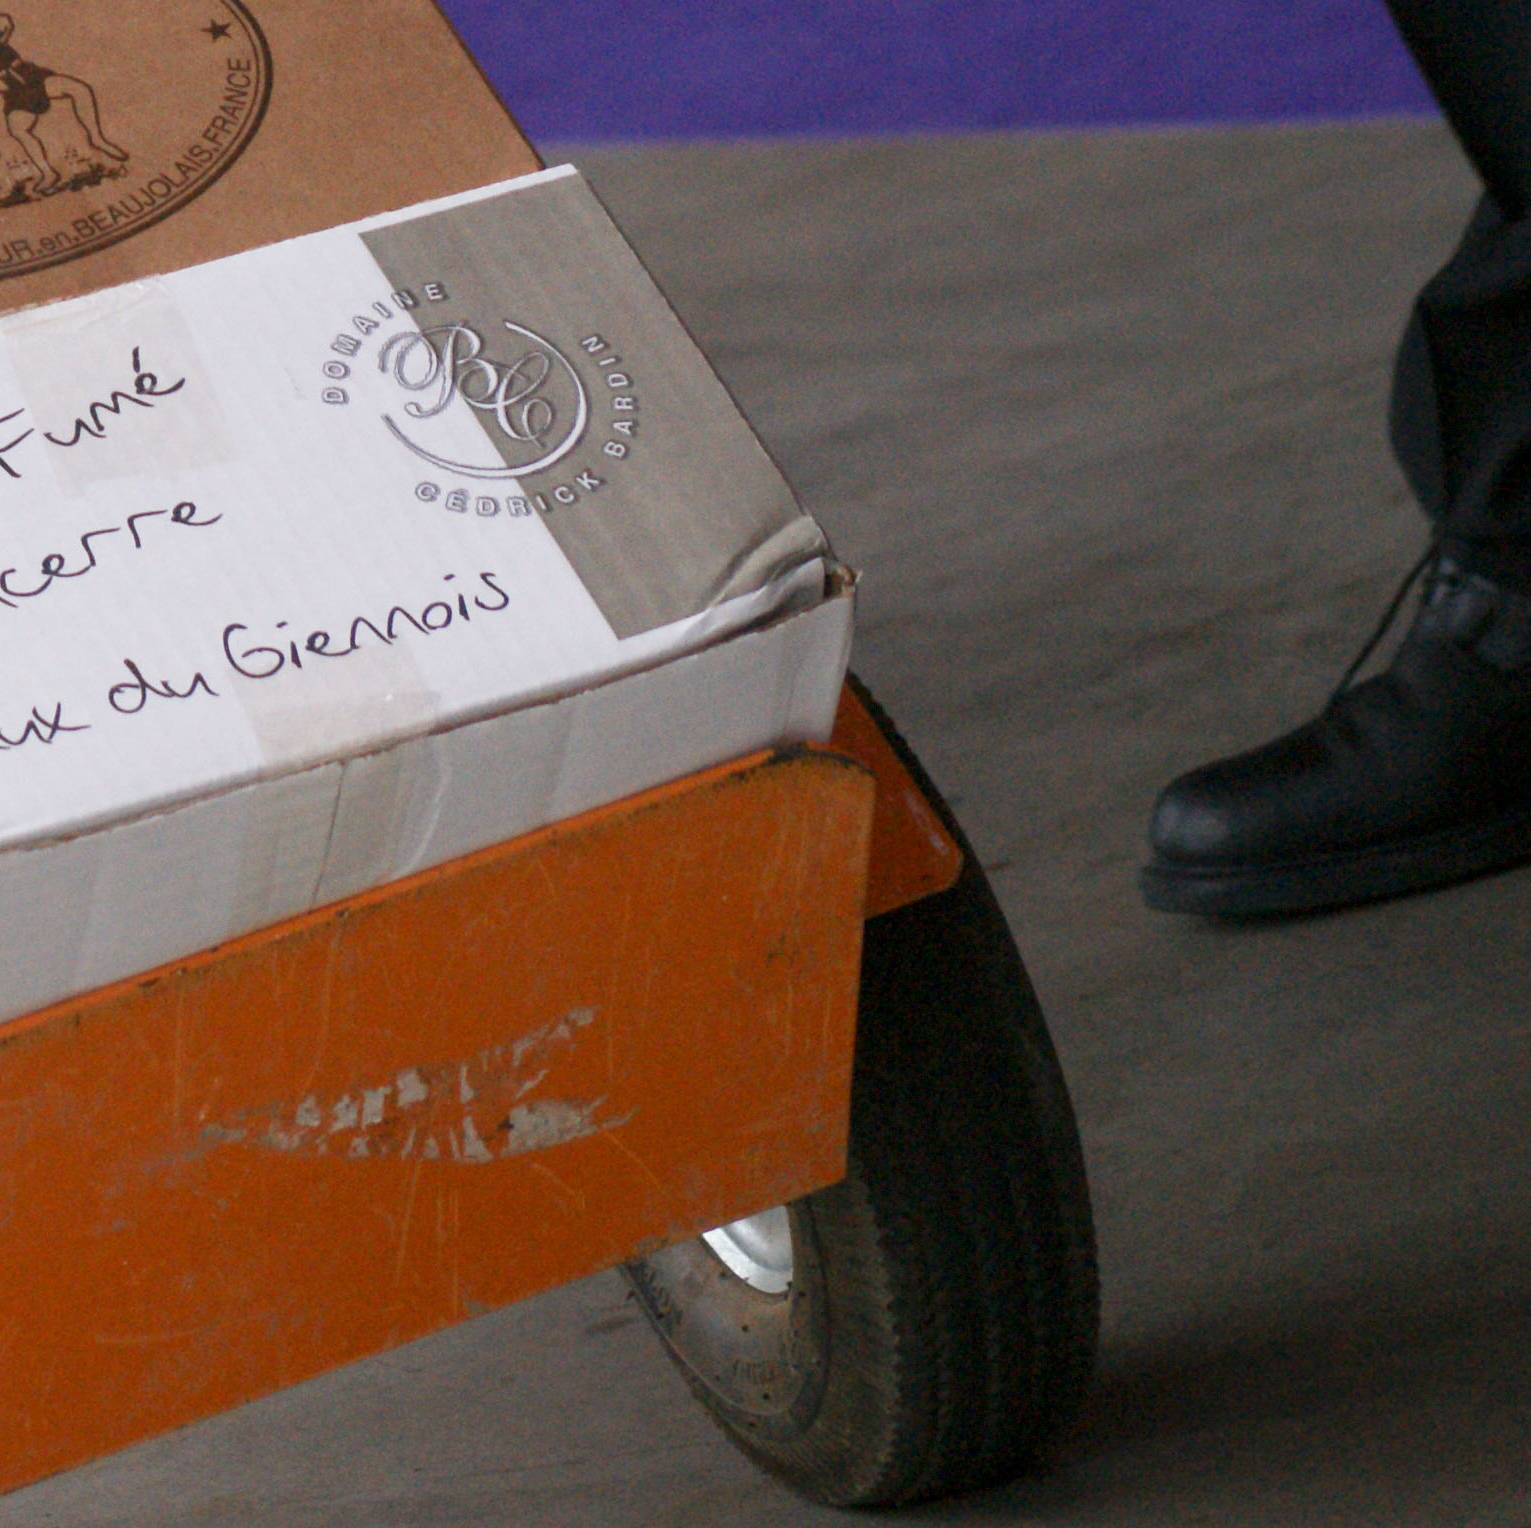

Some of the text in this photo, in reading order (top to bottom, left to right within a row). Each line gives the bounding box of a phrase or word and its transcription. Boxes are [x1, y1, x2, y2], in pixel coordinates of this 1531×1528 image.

[321, 281, 447, 405] DOMAINE
[580, 333, 639, 460] BARDIN
[414, 470, 605, 517] CÉDRICK
[106, 657, 221, 717] du
[221, 569, 512, 680] Giennois
